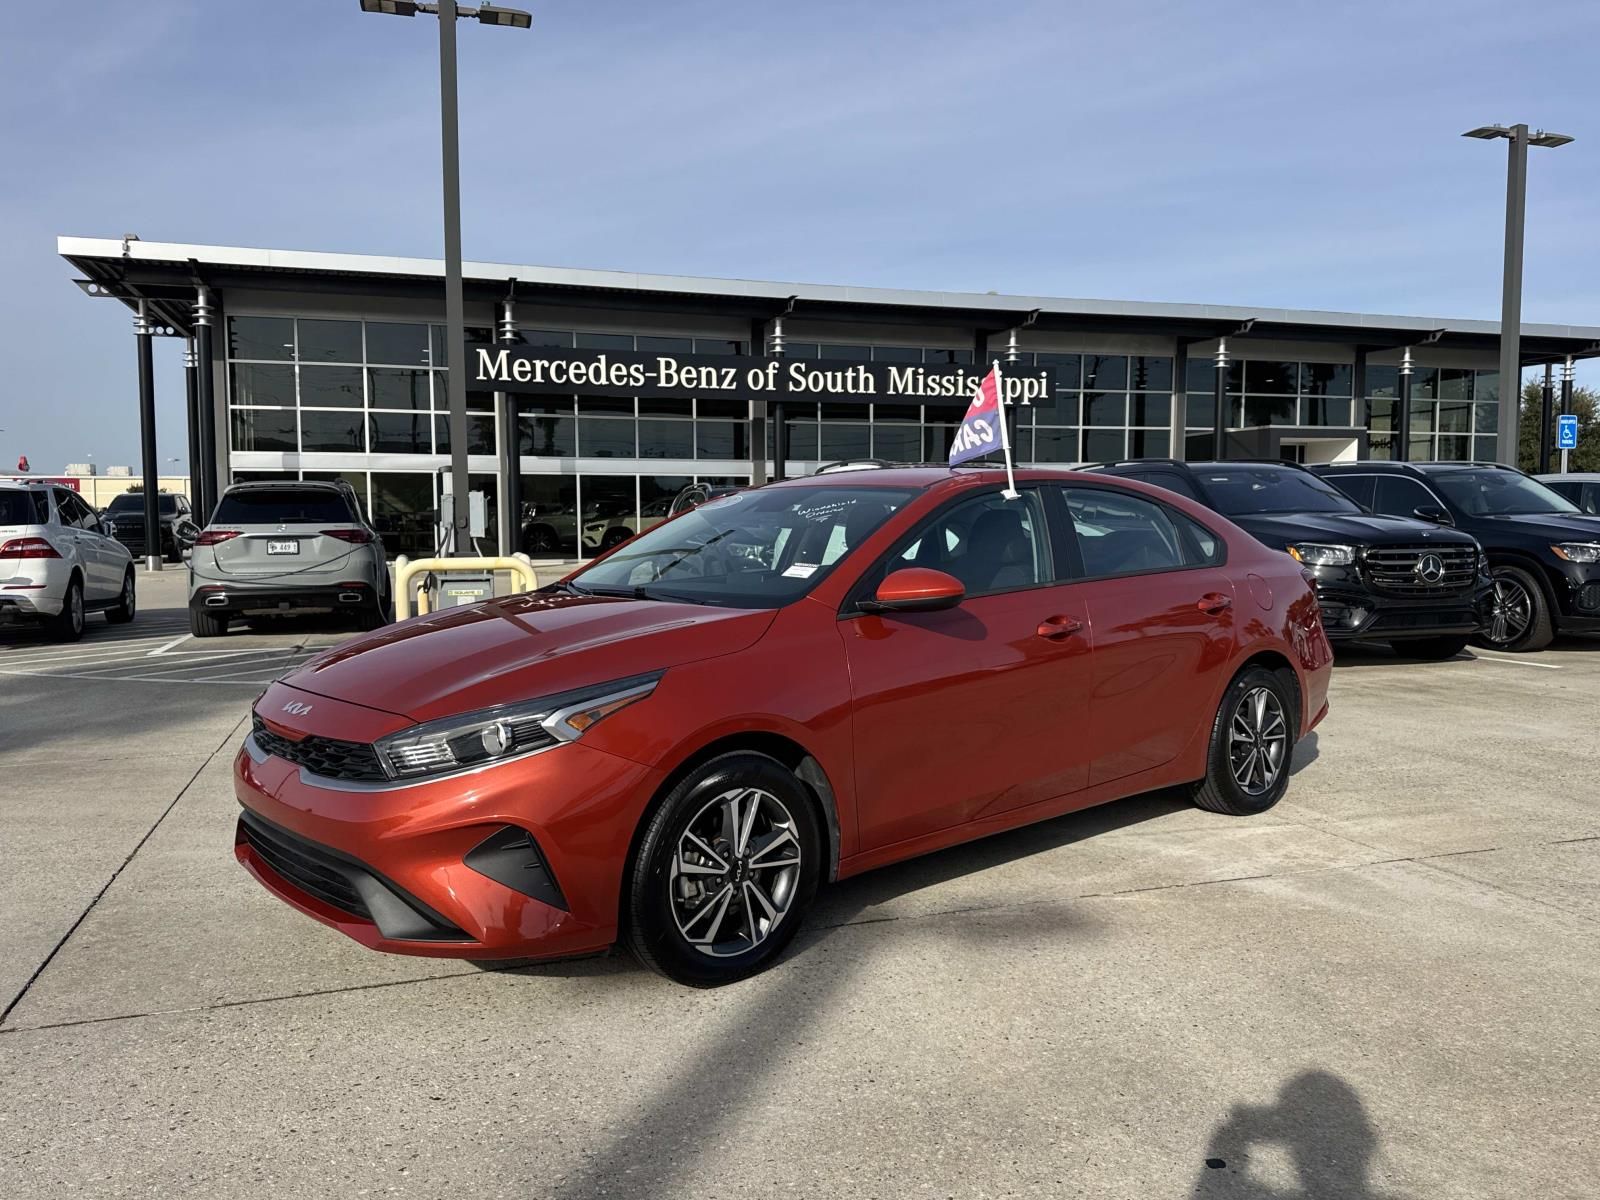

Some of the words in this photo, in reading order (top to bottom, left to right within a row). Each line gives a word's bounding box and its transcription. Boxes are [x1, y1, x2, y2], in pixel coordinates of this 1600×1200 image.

[475, 348, 738, 390] Mercedes-Benz
[747, 361, 780, 392] of
[788, 362, 877, 394] South
